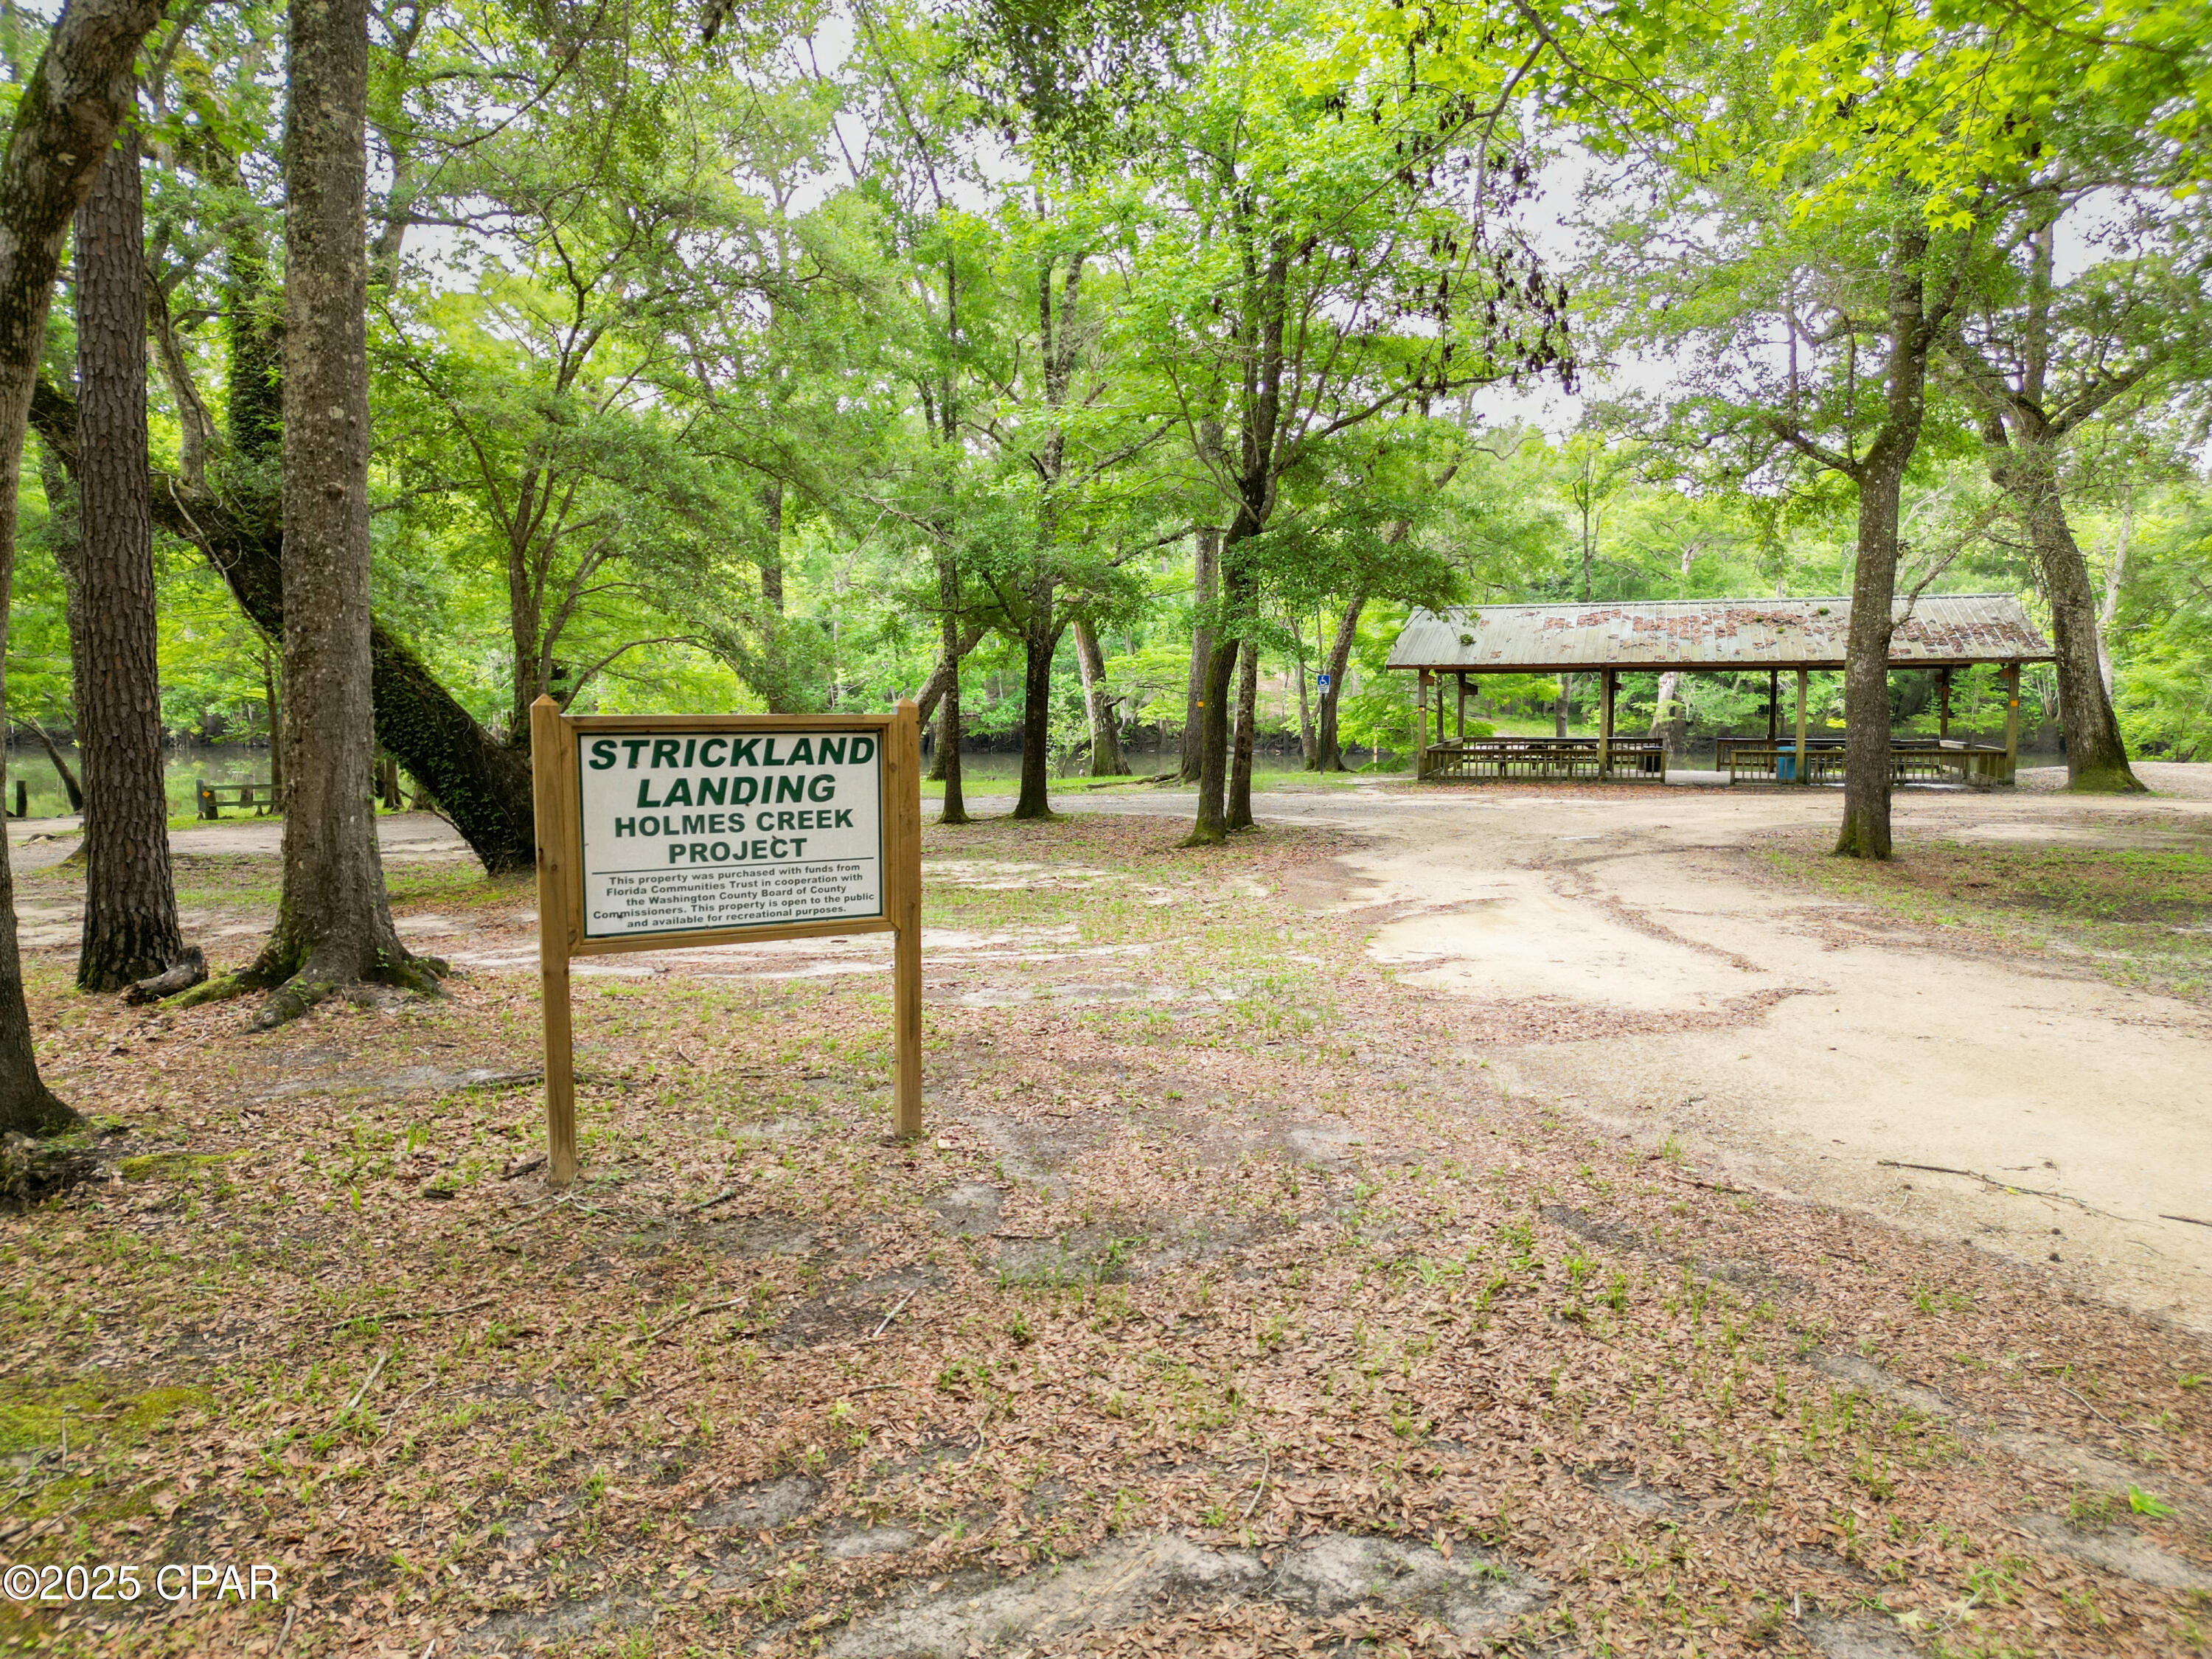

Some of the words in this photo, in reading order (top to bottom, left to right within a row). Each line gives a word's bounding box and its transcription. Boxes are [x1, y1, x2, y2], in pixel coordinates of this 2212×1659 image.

[588, 737, 875, 771] STRICKLAND
[636, 773, 836, 808] LANDING
[614, 813, 745, 838] HOLMES
[756, 808, 854, 831] CREEK
[669, 838, 807, 863] PROJECT
[606, 886, 647, 896] Florida
[651, 883, 726, 894] Communities
[729, 880, 758, 888] Trust
[762, 878, 771, 886] in
[774, 875, 838, 886] cooperation
[841, 873, 863, 882] with
[609, 876, 635, 885] This
[639, 873, 688, 885] property
[692, 872, 714, 880] was
[718, 868, 775, 880] purchased
[779, 866, 801, 875] with
[805, 865, 833, 874] funds
[836, 863, 860, 872] from
[593, 907, 687, 919] Commissioners.
[690, 904, 714, 912] This
[718, 900, 765, 912] property
[768, 899, 778, 907] is
[781, 898, 807, 907] open
[810, 896, 821, 904] to
[824, 894, 841, 903] the
[844, 892, 874, 903] public
[626, 897, 645, 906] the
[649, 892, 715, 904] Washington
[719, 889, 758, 900] County
[762, 888, 793, 897] Board
[796, 887, 807, 895] of
[810, 885, 846, 894] County
[627, 919, 648, 928] and
[652, 915, 704, 926] available
[707, 913, 723, 922] for
[726, 908, 792, 920] recreational
[796, 905, 846, 917] purposes.
